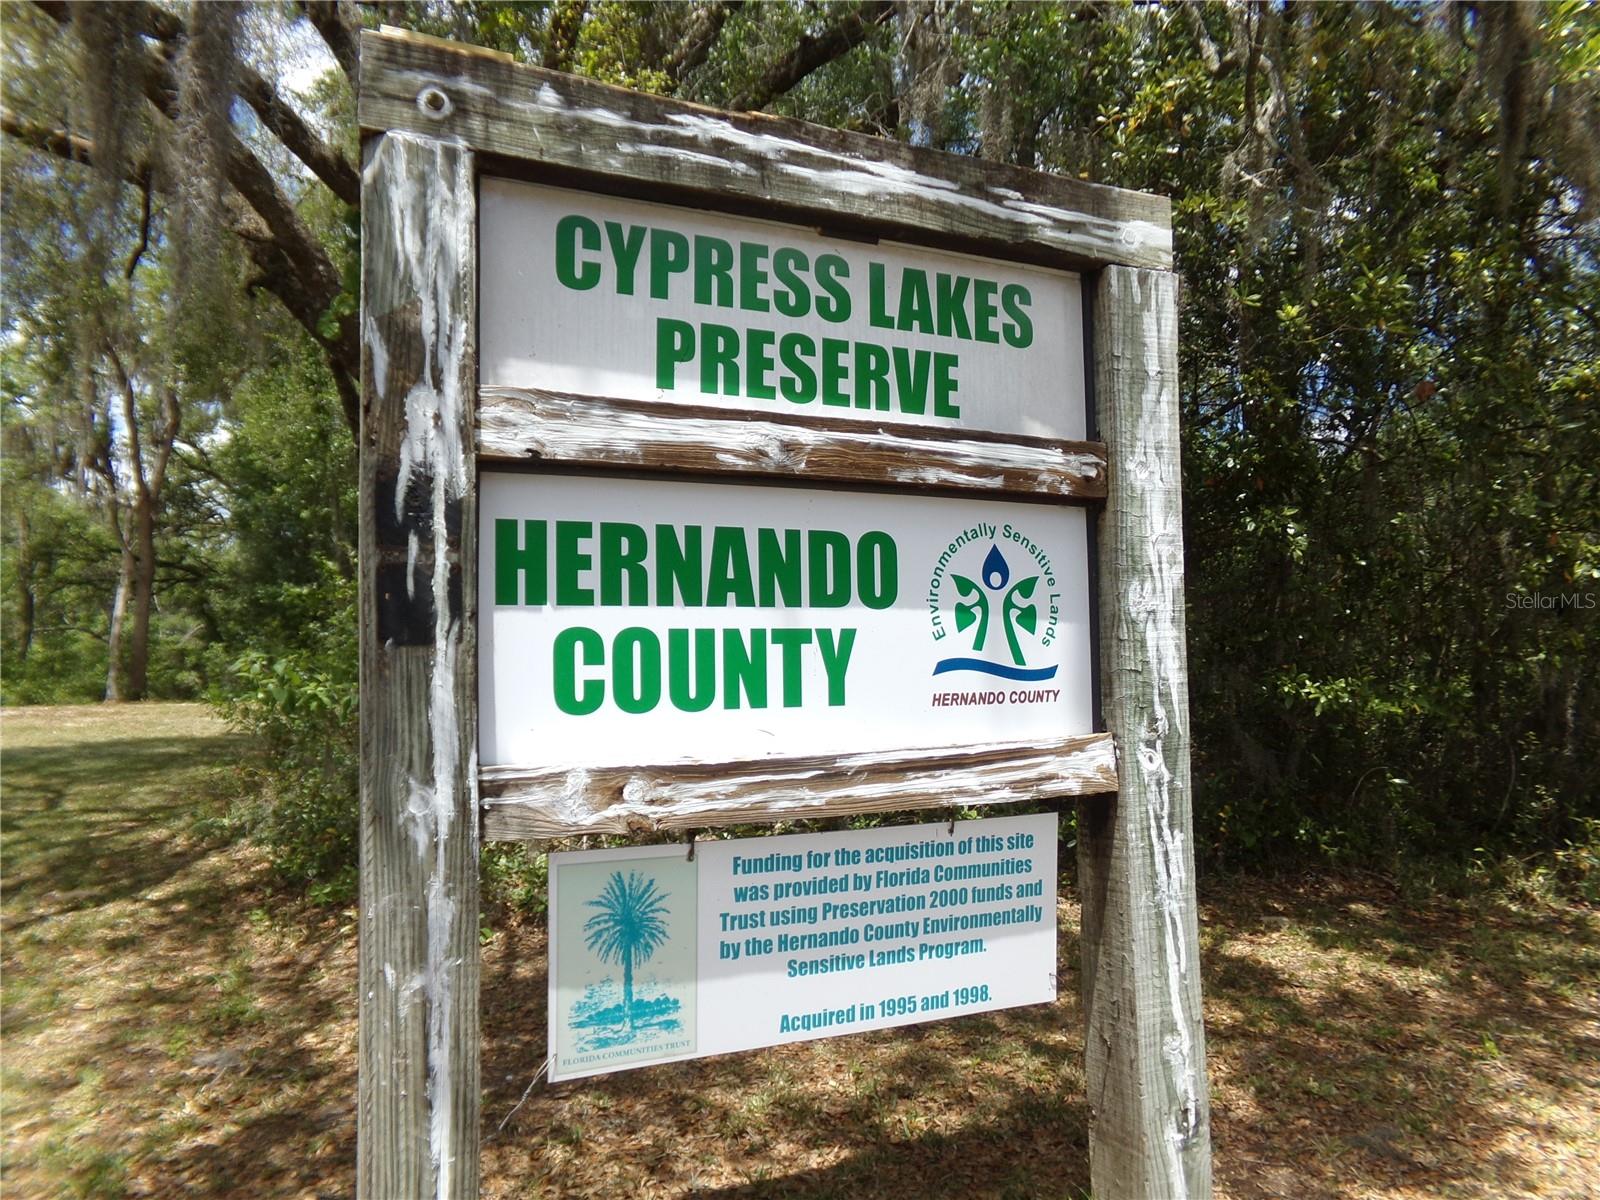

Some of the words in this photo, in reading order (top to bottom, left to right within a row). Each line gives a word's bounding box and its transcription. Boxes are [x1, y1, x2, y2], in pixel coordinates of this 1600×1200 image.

[555, 214, 851, 323] CYPRESS
[869, 261, 1034, 349] LAKES
[656, 317, 960, 419] PRESERVE
[495, 518, 898, 610] HERNANDO
[926, 522, 997, 641] Environmentally
[1002, 524, 1056, 587] Sensitive
[1041, 593, 1061, 647] Lands
[553, 626, 857, 716] COUNTY
[932, 690, 1005, 707] HERNANDO
[1009, 689, 1061, 705] COUNTY
[732, 853, 803, 875] Funding
[806, 850, 831, 869] for
[834, 848, 861, 866] the
[865, 841, 954, 863] acquisition
[958, 837, 973, 856] of
[975, 835, 1004, 853] this
[1006, 833, 1034, 850] site
[733, 884, 770, 903] was
[773, 874, 849, 901] provided
[853, 873, 872, 892] by
[875, 868, 930, 889] Florida
[934, 858, 1032, 883] Communities
[719, 910, 766, 932] Trust
[769, 906, 818, 926] using
[822, 894, 926, 921] Preservation
[929, 887, 968, 909] 2000
[971, 883, 1013, 904] funds
[1016, 879, 1043, 898] and
[719, 940, 741, 960] by
[744, 937, 773, 956] the
[777, 927, 860, 953] Hernando
[863, 921, 920, 942] County
[923, 904, 1043, 935] Environmentally
[787, 953, 865, 978] Sensitive
[869, 946, 915, 967] Lands
[919, 938, 987, 961] Program.
[779, 1005, 856, 1033] Acquired
[859, 1003, 875, 1021] in
[878, 995, 917, 1018] 1995
[920, 991, 950, 1012] and
[953, 984, 992, 1006] 1998.
[562, 1054, 601, 1066] FLORIDA
[602, 1045, 664, 1059] COMMUNITIES
[665, 1040, 691, 1050] TRUST
